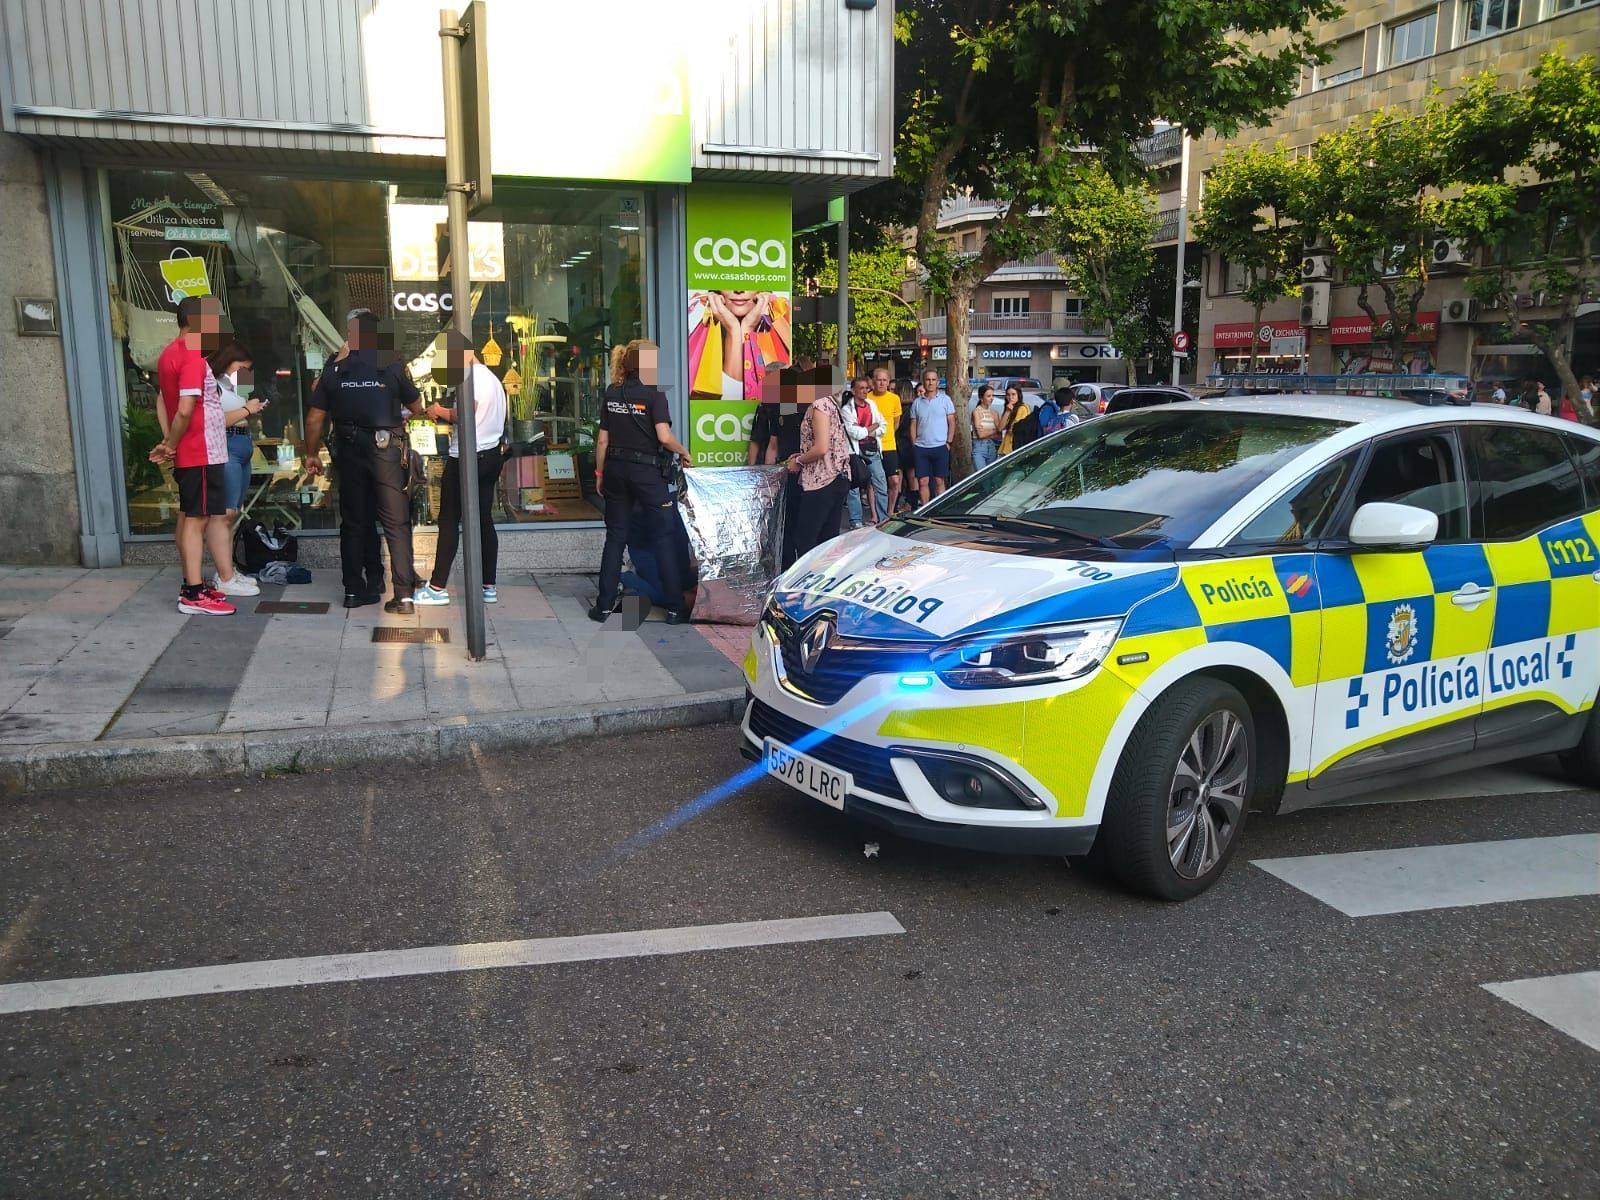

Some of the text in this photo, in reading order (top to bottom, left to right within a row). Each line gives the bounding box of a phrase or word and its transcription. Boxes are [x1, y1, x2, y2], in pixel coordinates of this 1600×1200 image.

[145, 214, 216, 225] Utiliza nuestro
[130, 230, 164, 238] servicio
[694, 237, 786, 268] casa
[176, 277, 206, 289] casa
[694, 271, 786, 283] www.casashops.com
[982, 350, 1032, 358] ORTOPINOS
[696, 413, 755, 442] cas
[1553, 537, 1595, 564] 112
[1066, 561, 1113, 581] 700
[1200, 575, 1274, 605] Policía
[1382, 641, 1551, 717] Policía Local
[770, 746, 841, 801] 5578 LRC
